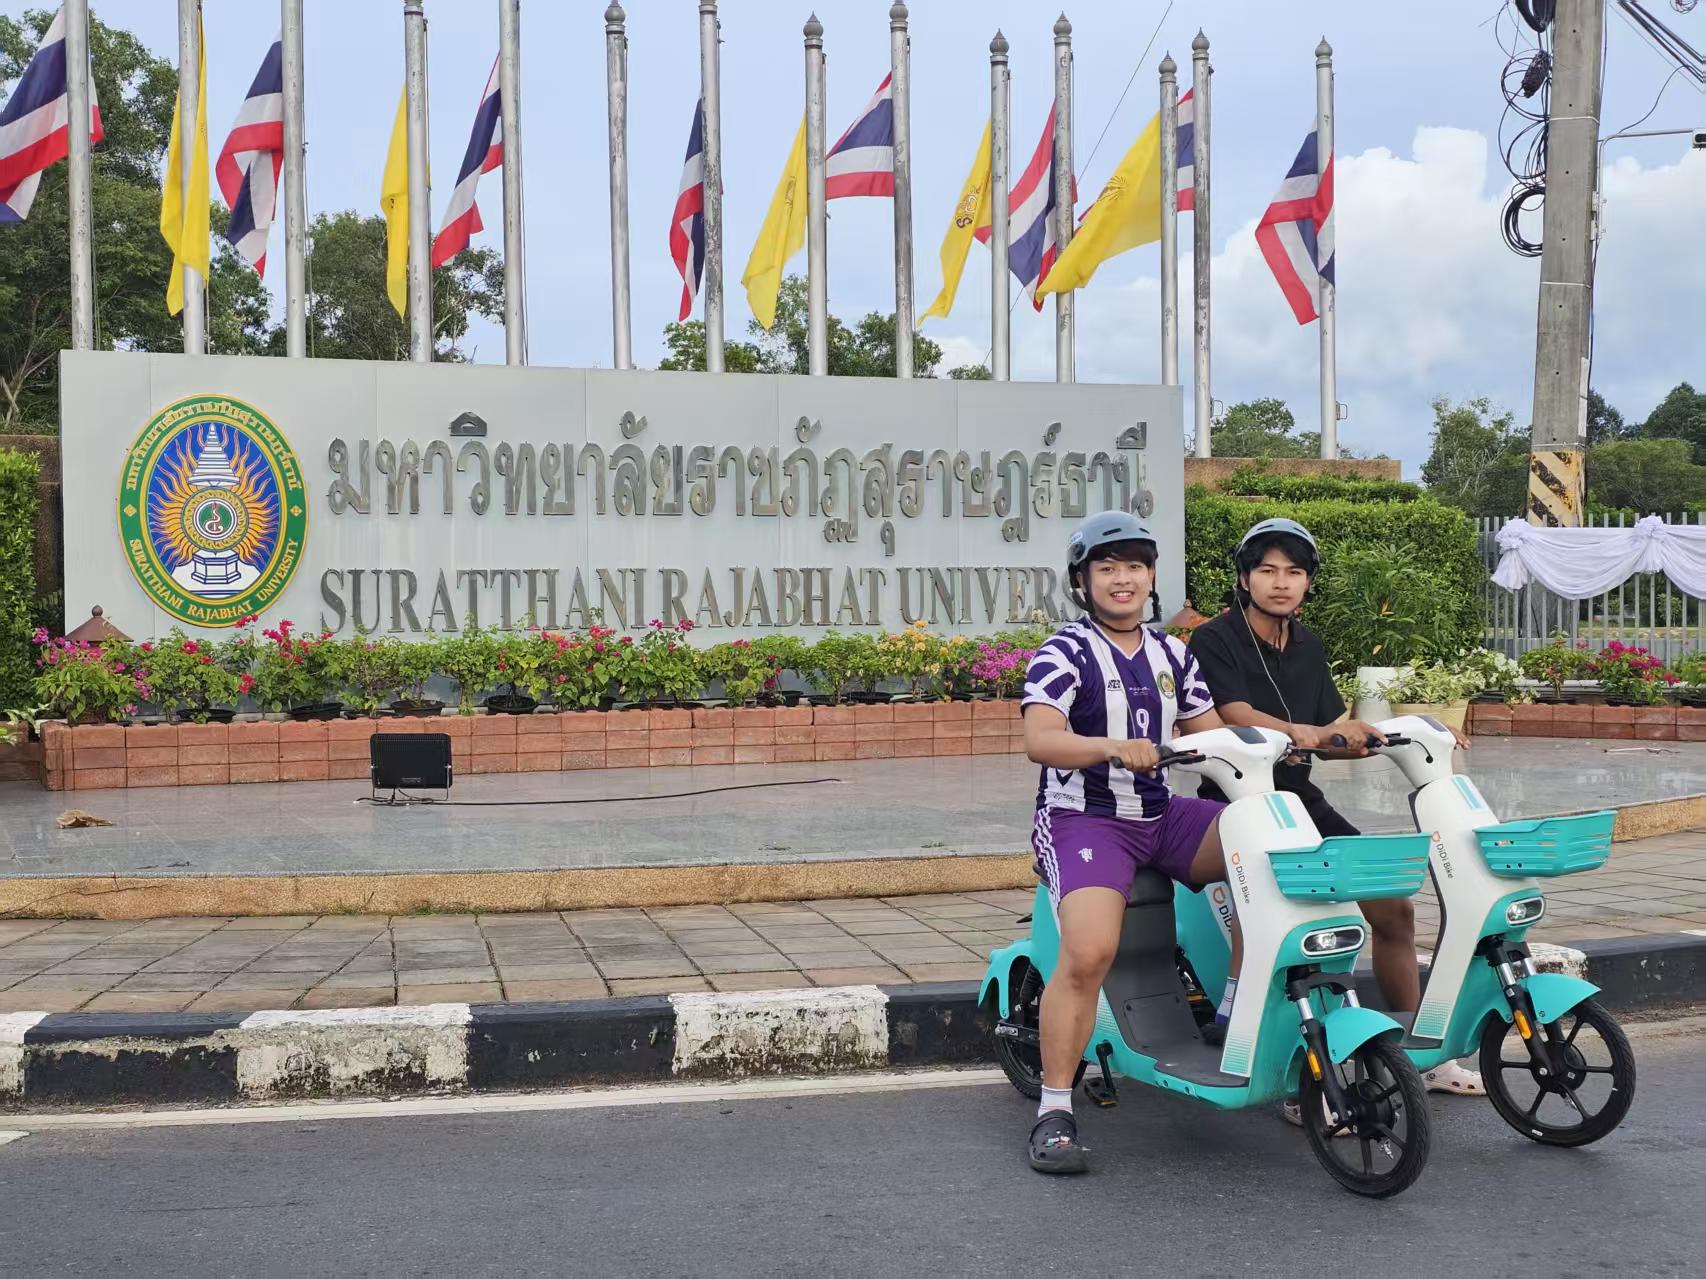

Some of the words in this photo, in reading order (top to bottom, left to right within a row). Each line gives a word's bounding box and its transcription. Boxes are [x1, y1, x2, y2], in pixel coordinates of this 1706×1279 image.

[327, 410, 1154, 556] มหาวิทยาลัยราชภัฏสุราษฎร์ธานี
[130, 538, 184, 609] SURATTHANI
[187, 600, 254, 622] RAJABHAT
[256, 538, 299, 602] UNIVERSITY
[320, 566, 648, 635] SURATTHANI
[660, 566, 886, 628] RAJABHAT
[898, 566, 1083, 625] UNIVERS
[1136, 708, 1149, 737] 9
[1436, 843, 1449, 861] DiDi
[1235, 865, 1245, 885] DiDi
[1241, 886, 1250, 904] Bike
[1219, 904, 1233, 932] DiD
